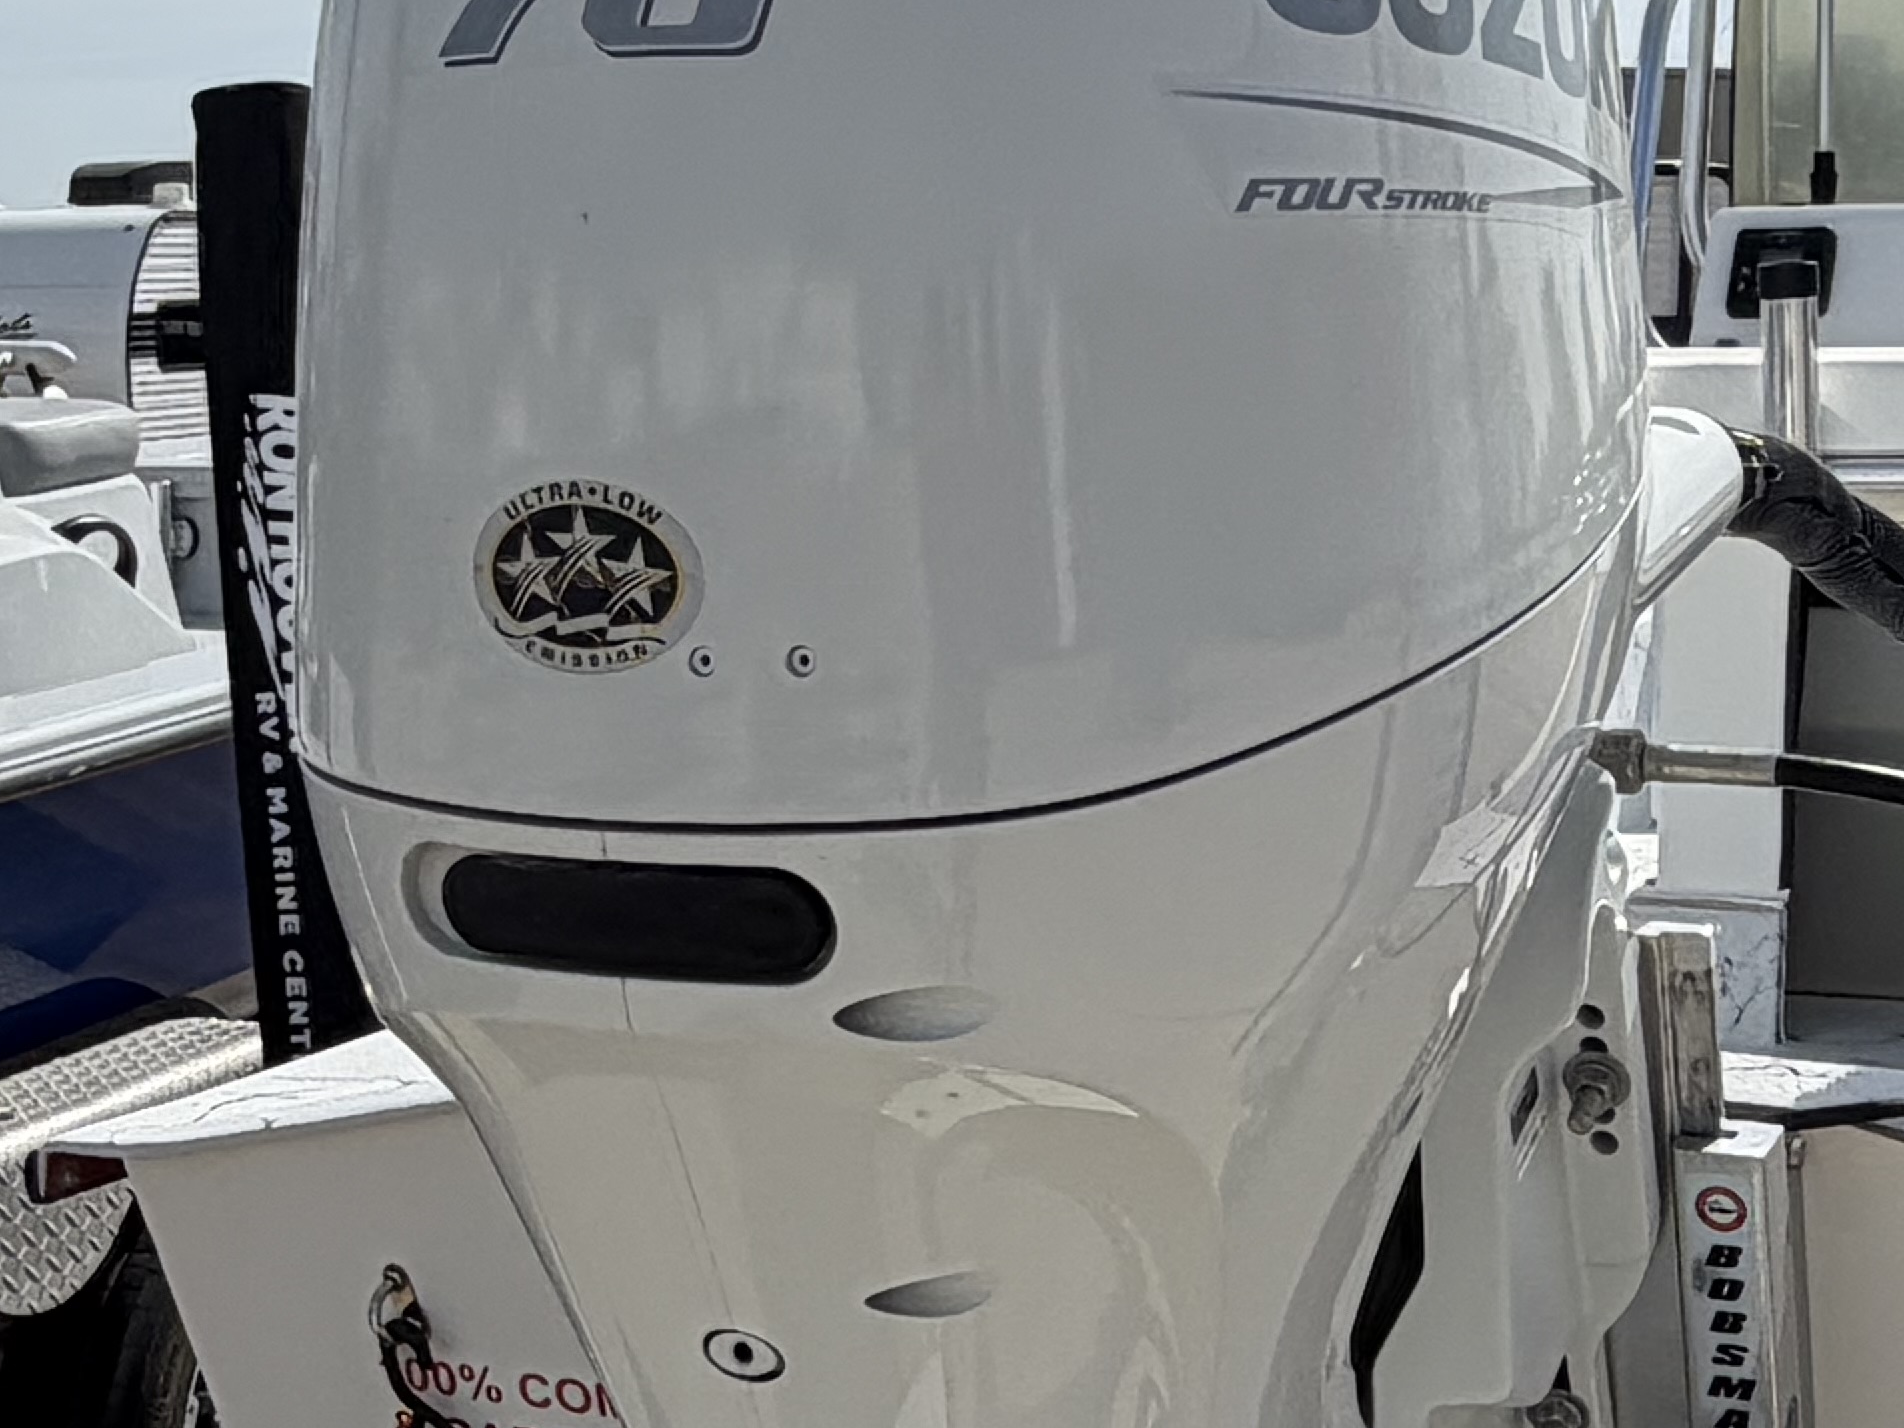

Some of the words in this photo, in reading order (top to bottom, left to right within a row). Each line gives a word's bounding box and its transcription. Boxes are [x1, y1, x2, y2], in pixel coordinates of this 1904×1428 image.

[254, 691, 282, 741] RV
[262, 750, 284, 773] &
[266, 786, 302, 936] MARINE
[282, 949, 313, 1056] CENT
[404, 1357, 503, 1404] 00%
